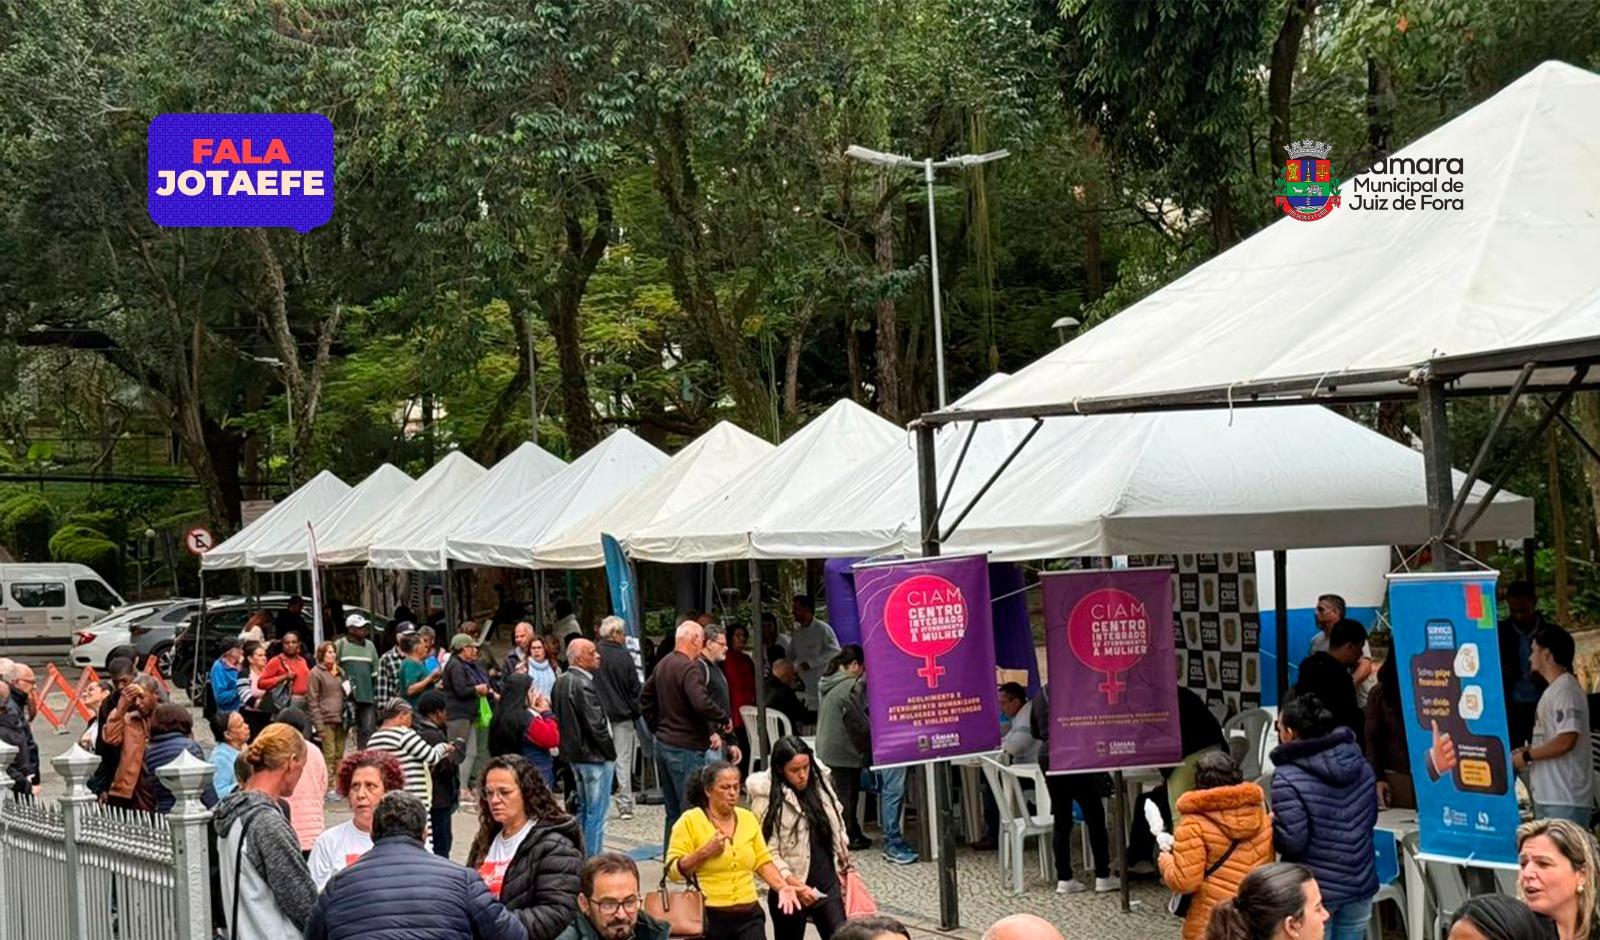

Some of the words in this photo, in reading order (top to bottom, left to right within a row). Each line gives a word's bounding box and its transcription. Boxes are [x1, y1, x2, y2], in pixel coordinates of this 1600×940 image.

[907, 587, 962, 606] CIAM
[908, 603, 963, 620] CENTRO
[1091, 602, 1146, 620] CIAM
[909, 615, 965, 629] INTEGRADO
[1092, 619, 1146, 633] CENTRO
[922, 629, 965, 642] MULHER
[1092, 631, 1147, 642] INTEGRADO
[1104, 645, 1148, 656] MULHER
